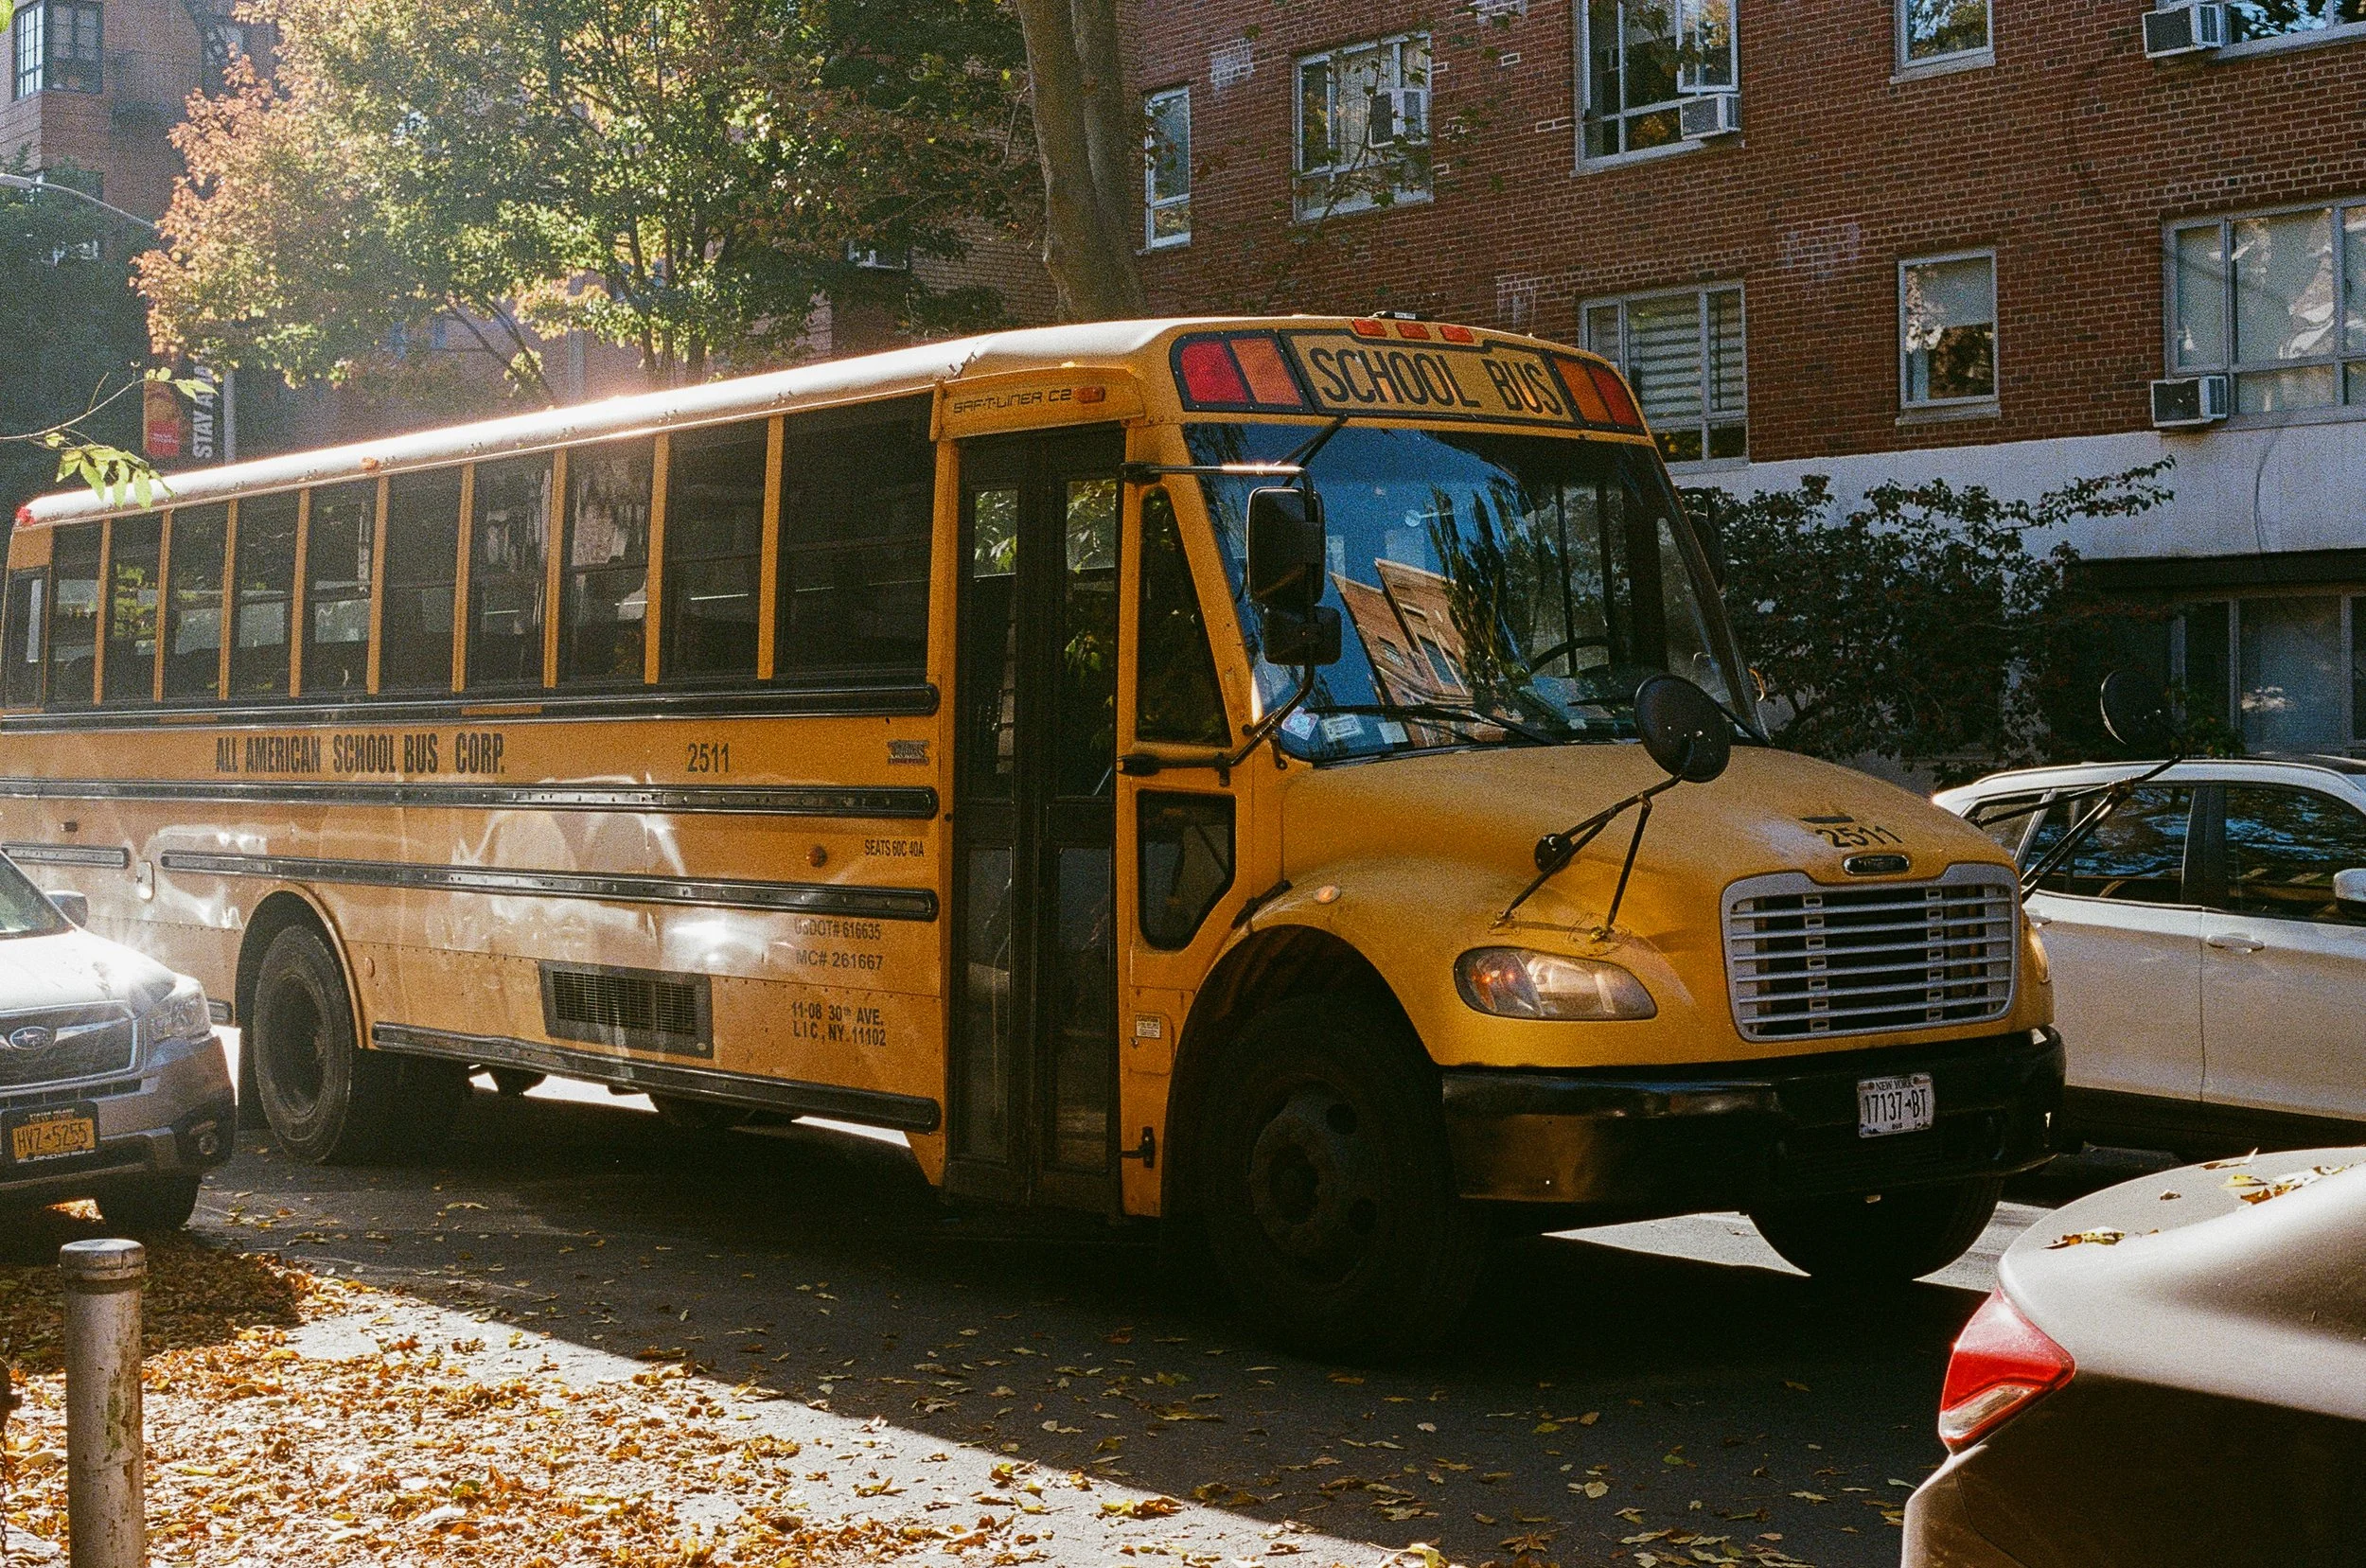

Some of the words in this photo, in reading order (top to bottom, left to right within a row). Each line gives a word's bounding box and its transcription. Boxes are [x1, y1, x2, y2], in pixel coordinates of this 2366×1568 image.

[1310, 347, 1481, 408] SCHOOL
[1481, 359, 1563, 415] BUS
[953, 392, 1043, 414] SAF-T-LINER
[1048, 388, 1072, 402] C2
[192, 410, 214, 459] STAY
[216, 736, 238, 773] ALL
[246, 736, 322, 773] AMERICAN
[333, 733, 397, 774] SCHOOL
[404, 732, 439, 774] BUS
[455, 732, 505, 774] CORP.
[687, 742, 730, 773] 2511
[865, 839, 891, 856] SEATS
[892, 840, 907, 856] 60C
[909, 840, 924, 857] 40A
[1815, 825, 1903, 848] 2511
[794, 918, 839, 938] USDOT#
[842, 921, 881, 941] 616635
[795, 949, 827, 967] MC#
[832, 952, 884, 971] 261667
[856, 1007, 884, 1026] AVE.
[853, 1026, 886, 1047] 11102
[1876, 1081, 1893, 1092] NEW
[1894, 1077, 1914, 1089] YORK
